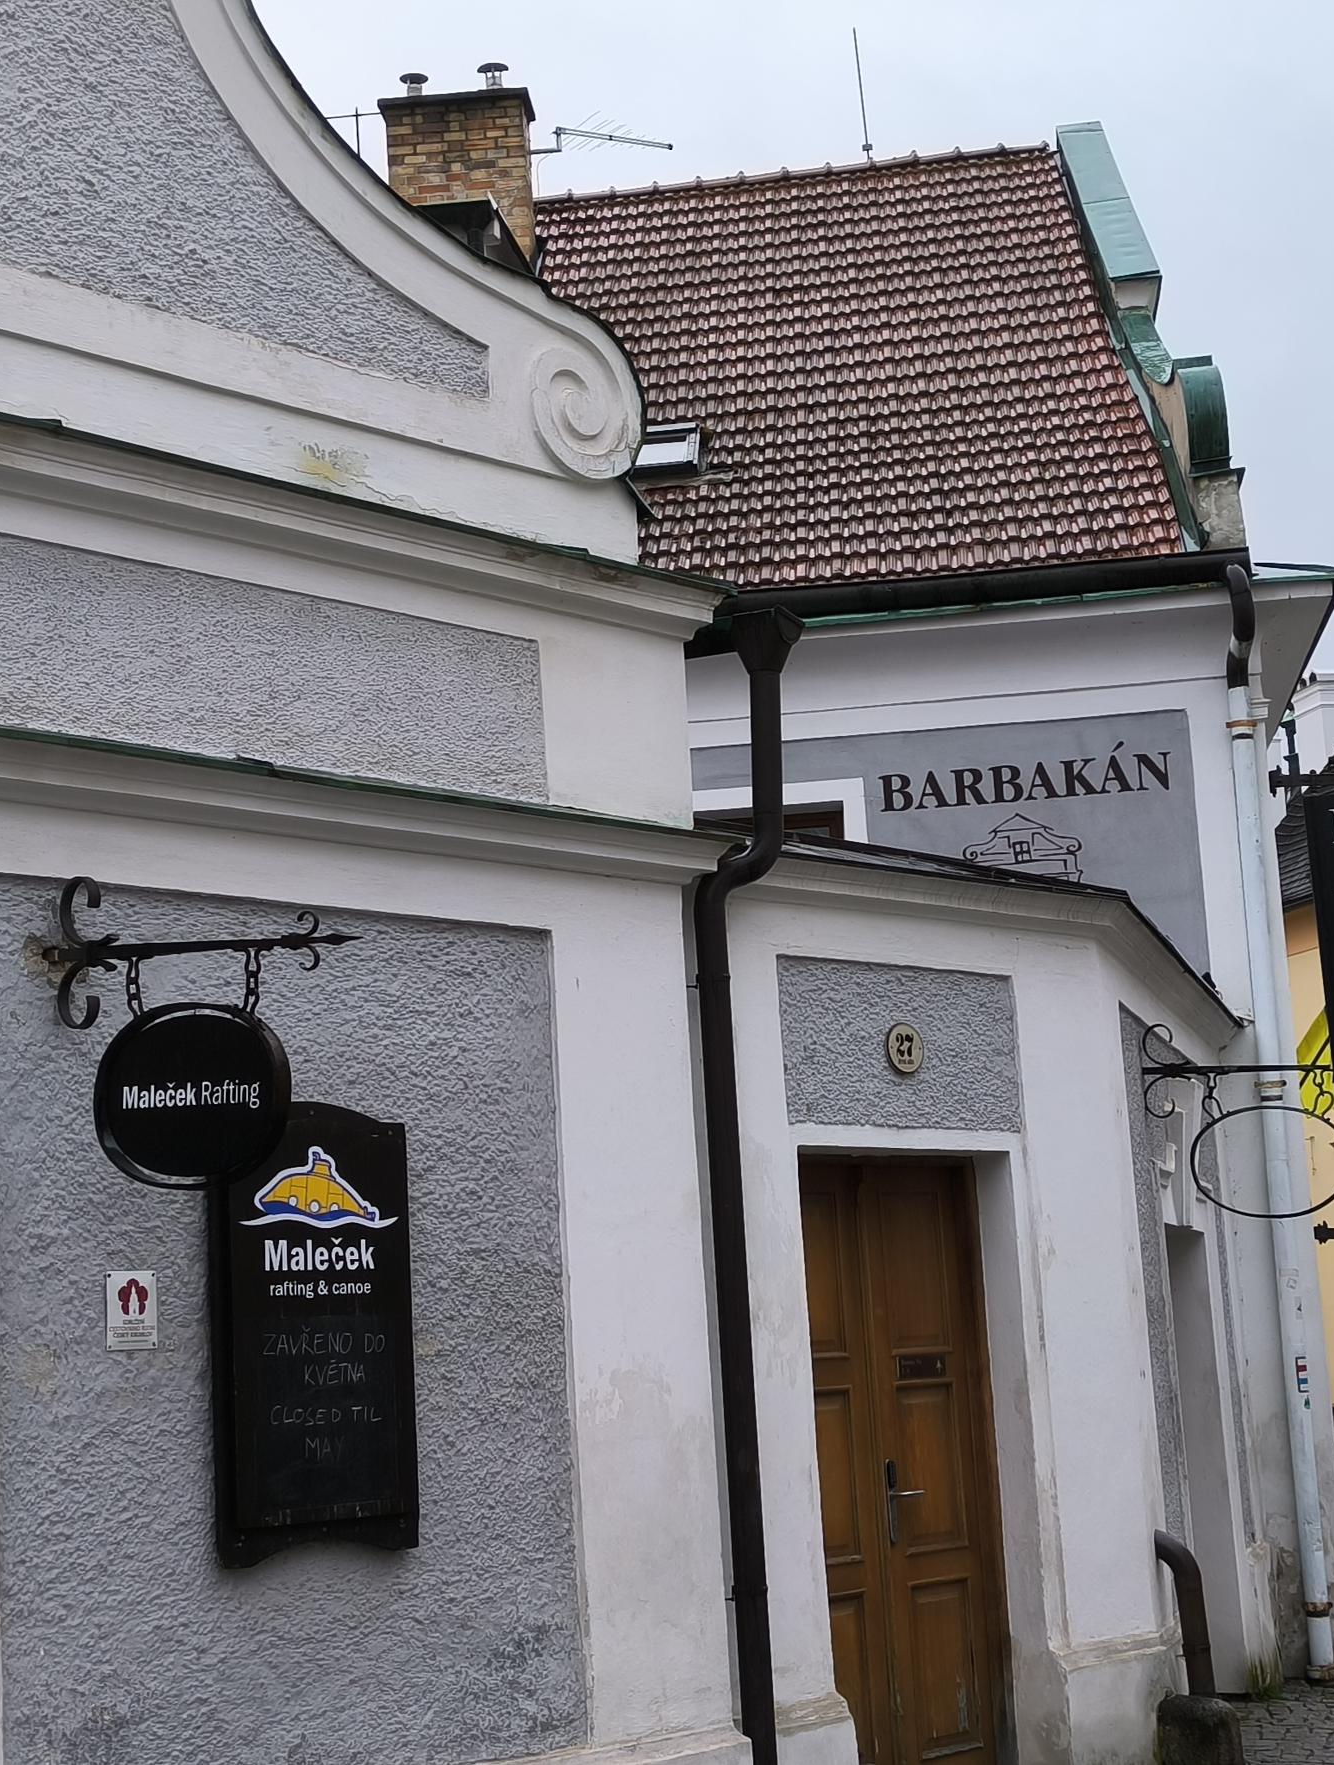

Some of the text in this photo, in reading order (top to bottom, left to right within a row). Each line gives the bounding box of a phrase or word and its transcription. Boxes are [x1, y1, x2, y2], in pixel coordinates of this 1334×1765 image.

[878, 740, 1172, 812] BARBAKÁN
[895, 1032, 914, 1058] 27
[122, 1079, 261, 1110] Maleček Rafting
[264, 1237, 376, 1271] Maleček
[270, 1280, 372, 1299] rafting & canoe
[263, 1324, 386, 1356] ZAVŘENO DO
[270, 1404, 383, 1426] CLOSED TIL
[305, 1436, 345, 1461] MAY
